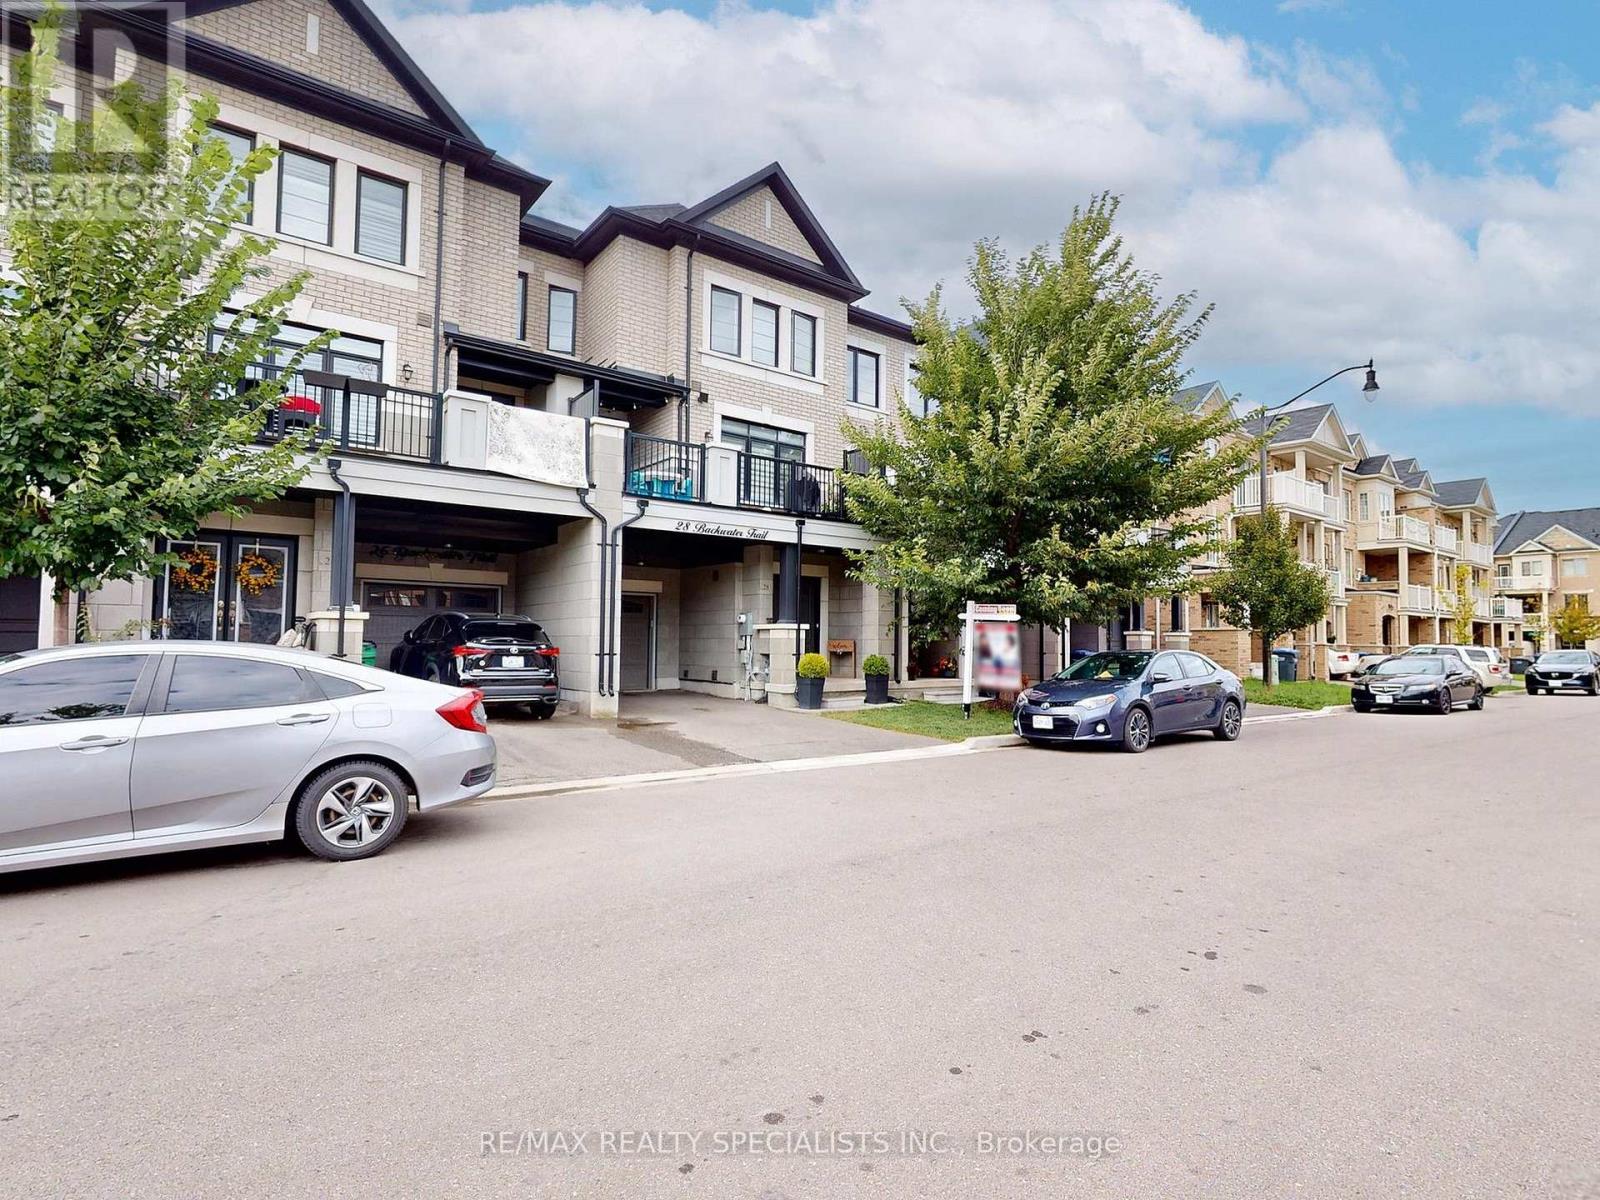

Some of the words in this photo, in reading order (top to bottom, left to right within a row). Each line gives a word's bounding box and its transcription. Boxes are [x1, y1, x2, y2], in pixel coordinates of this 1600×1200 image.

[675, 521, 691, 531] 28
[692, 522, 743, 537] Backwater
[746, 528, 769, 540] Trail
